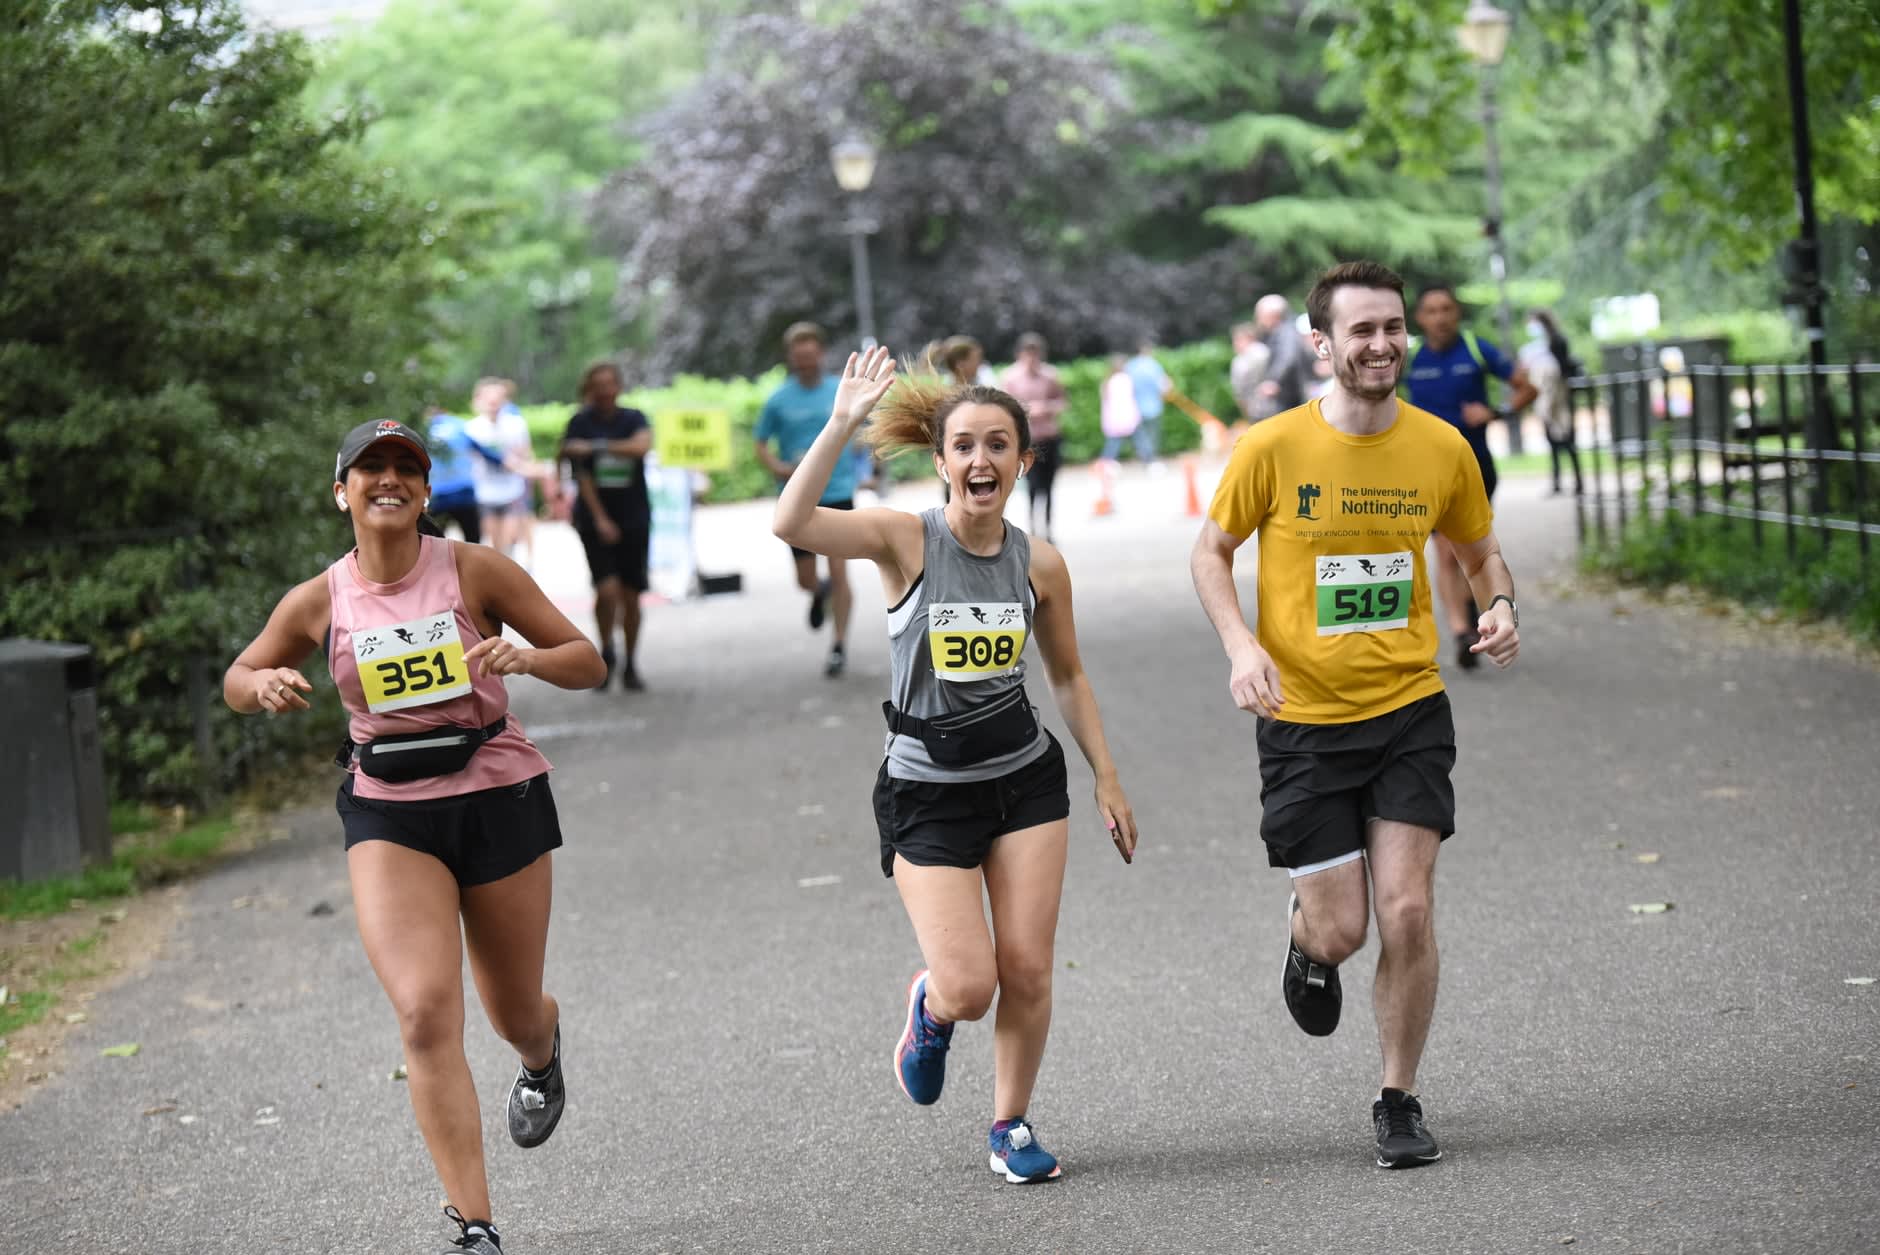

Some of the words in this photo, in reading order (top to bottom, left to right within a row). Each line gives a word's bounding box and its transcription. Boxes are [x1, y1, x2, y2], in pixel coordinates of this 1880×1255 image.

[1341, 487, 1359, 497] The
[1361, 487, 1407, 499] University
[1408, 489, 1418, 498] of
[1342, 500, 1427, 519] Nottingham
[1295, 529, 1321, 538] UNITED
[1324, 529, 1360, 537] KINGDOM
[1335, 586, 1400, 621] 519
[944, 635, 1014, 668] 308
[376, 651, 456, 696] 351
